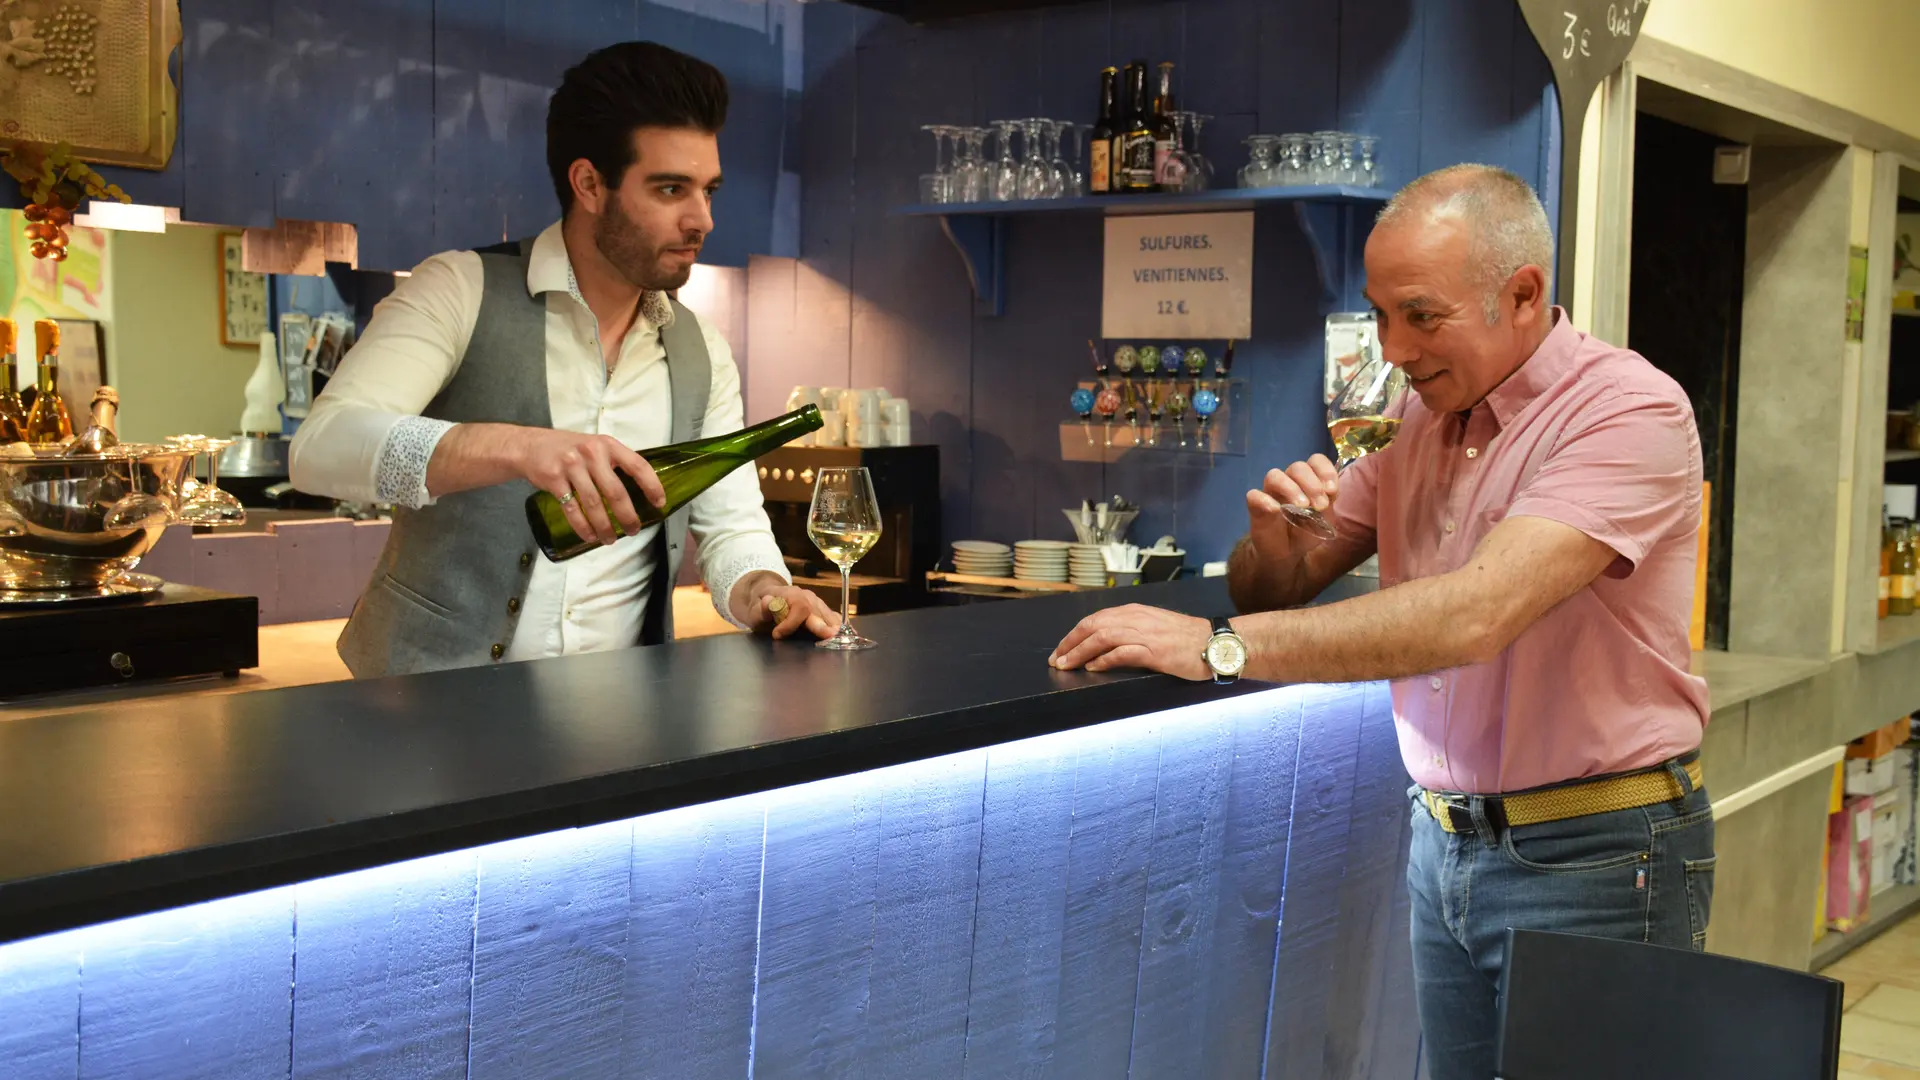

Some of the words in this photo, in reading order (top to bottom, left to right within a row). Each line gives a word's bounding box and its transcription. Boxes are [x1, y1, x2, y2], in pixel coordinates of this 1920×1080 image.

[1139, 235, 1212, 251] SULFURES.
[1133, 267, 1229, 283] VENITIENNES.
[1157, 300, 1174, 315] 12
